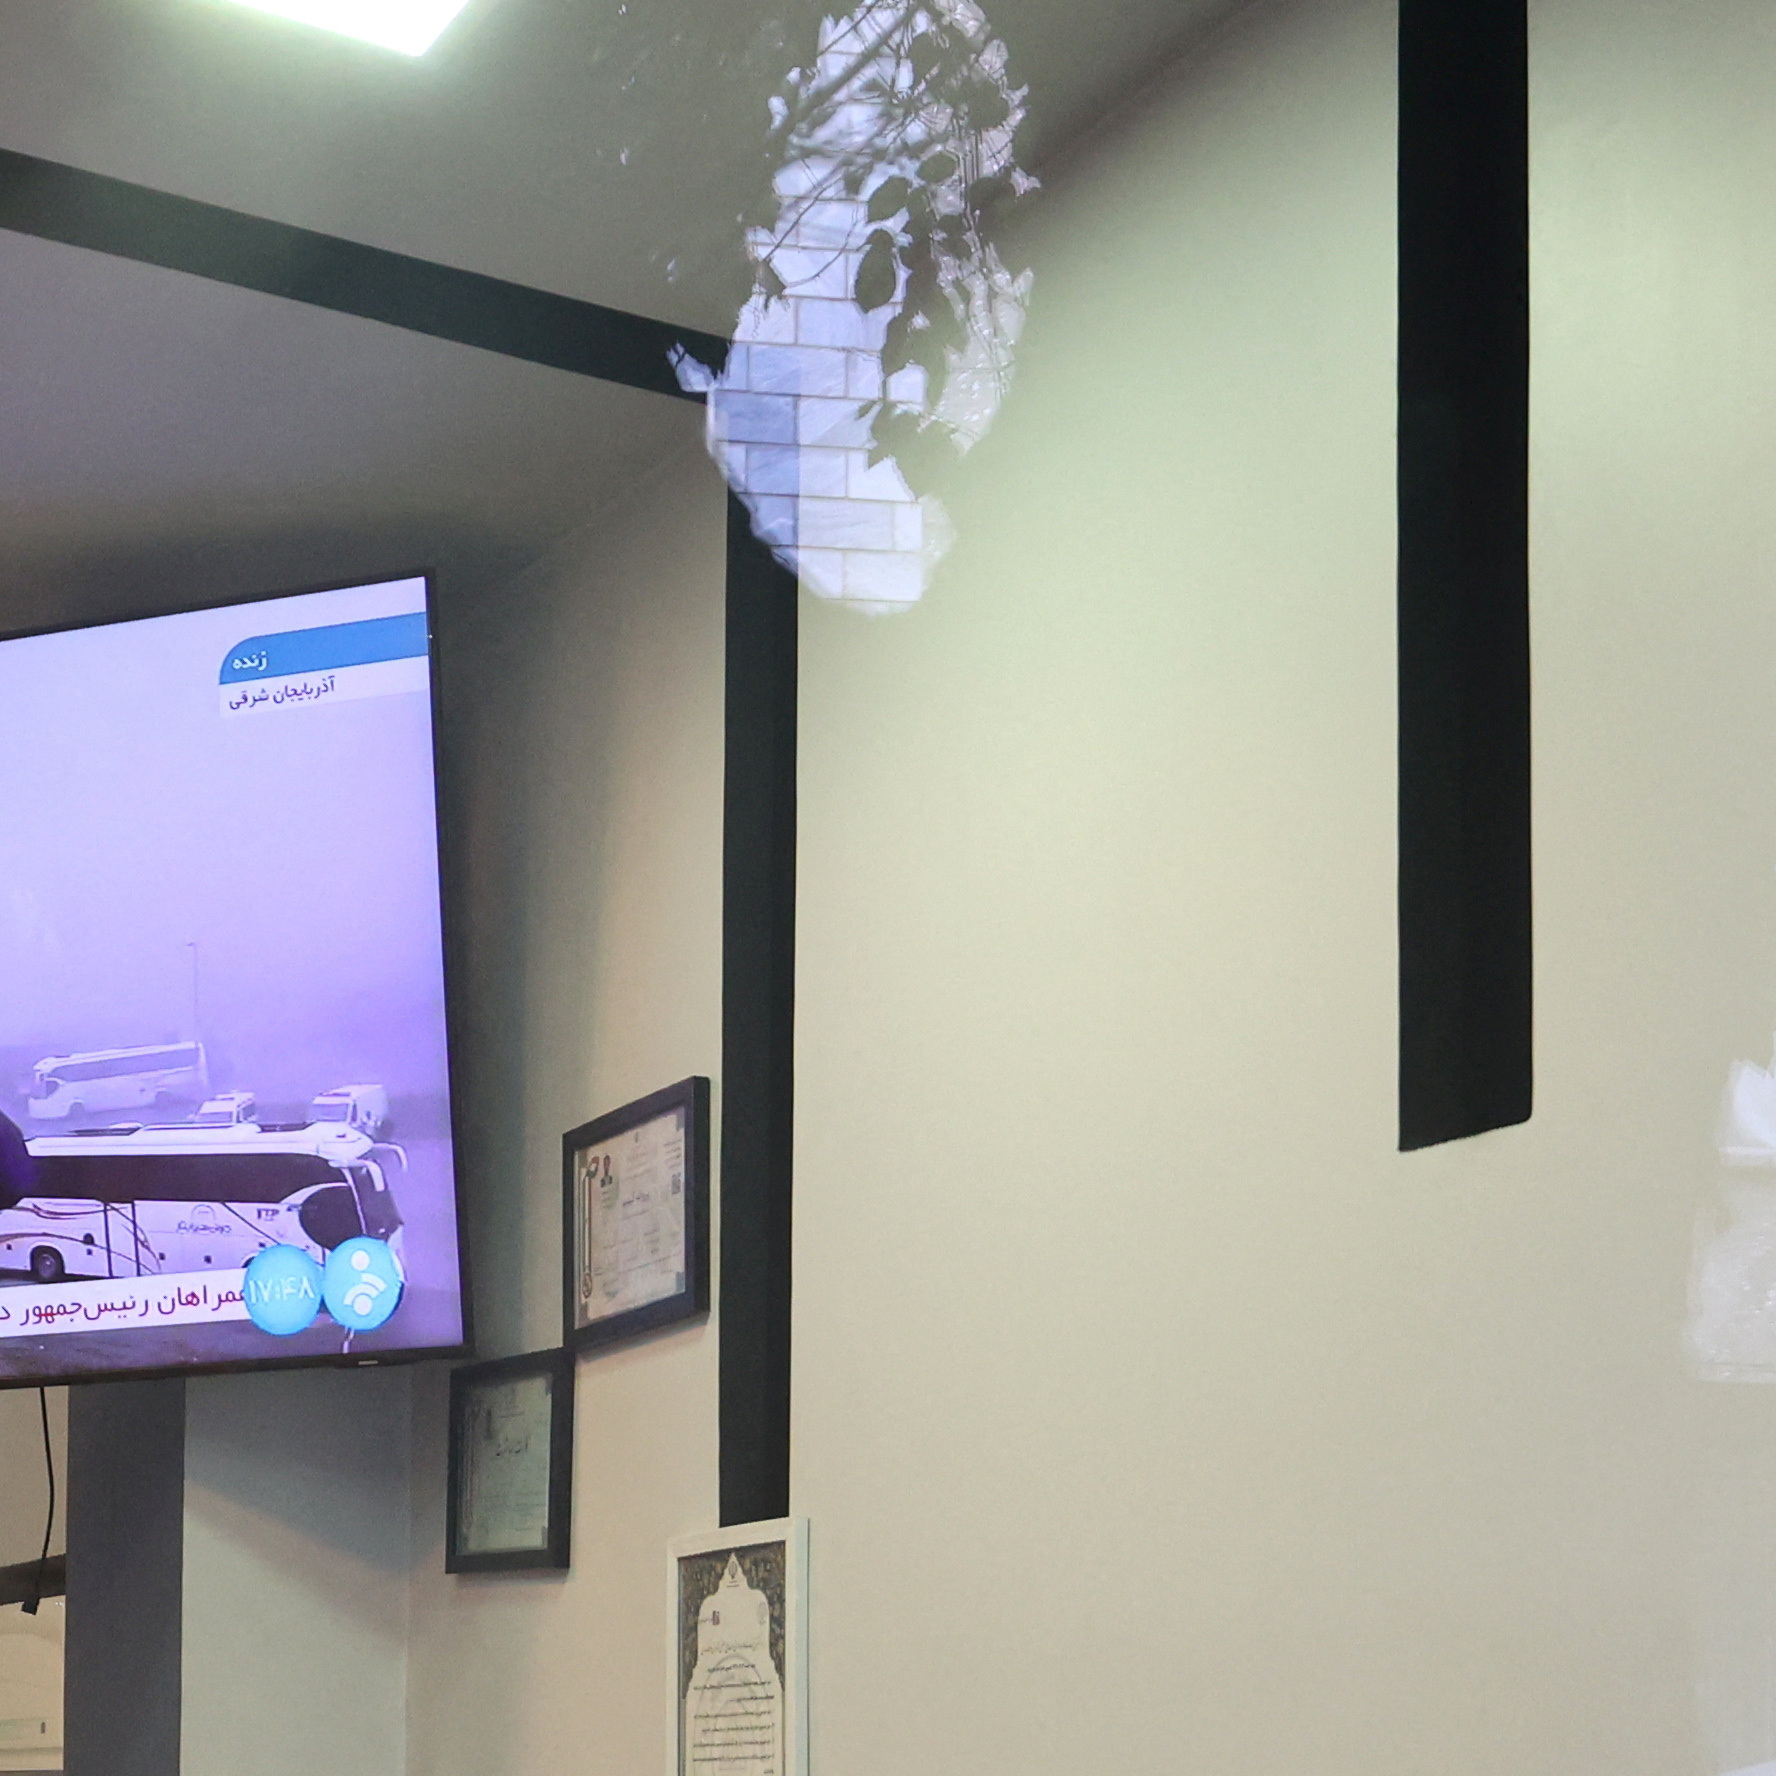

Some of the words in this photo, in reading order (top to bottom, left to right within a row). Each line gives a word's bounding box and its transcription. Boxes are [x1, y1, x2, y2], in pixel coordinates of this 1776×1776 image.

[231, 650, 268, 671] زنده
[228, 686, 270, 711] شرقی
[272, 675, 336, 704] آذربایجان
